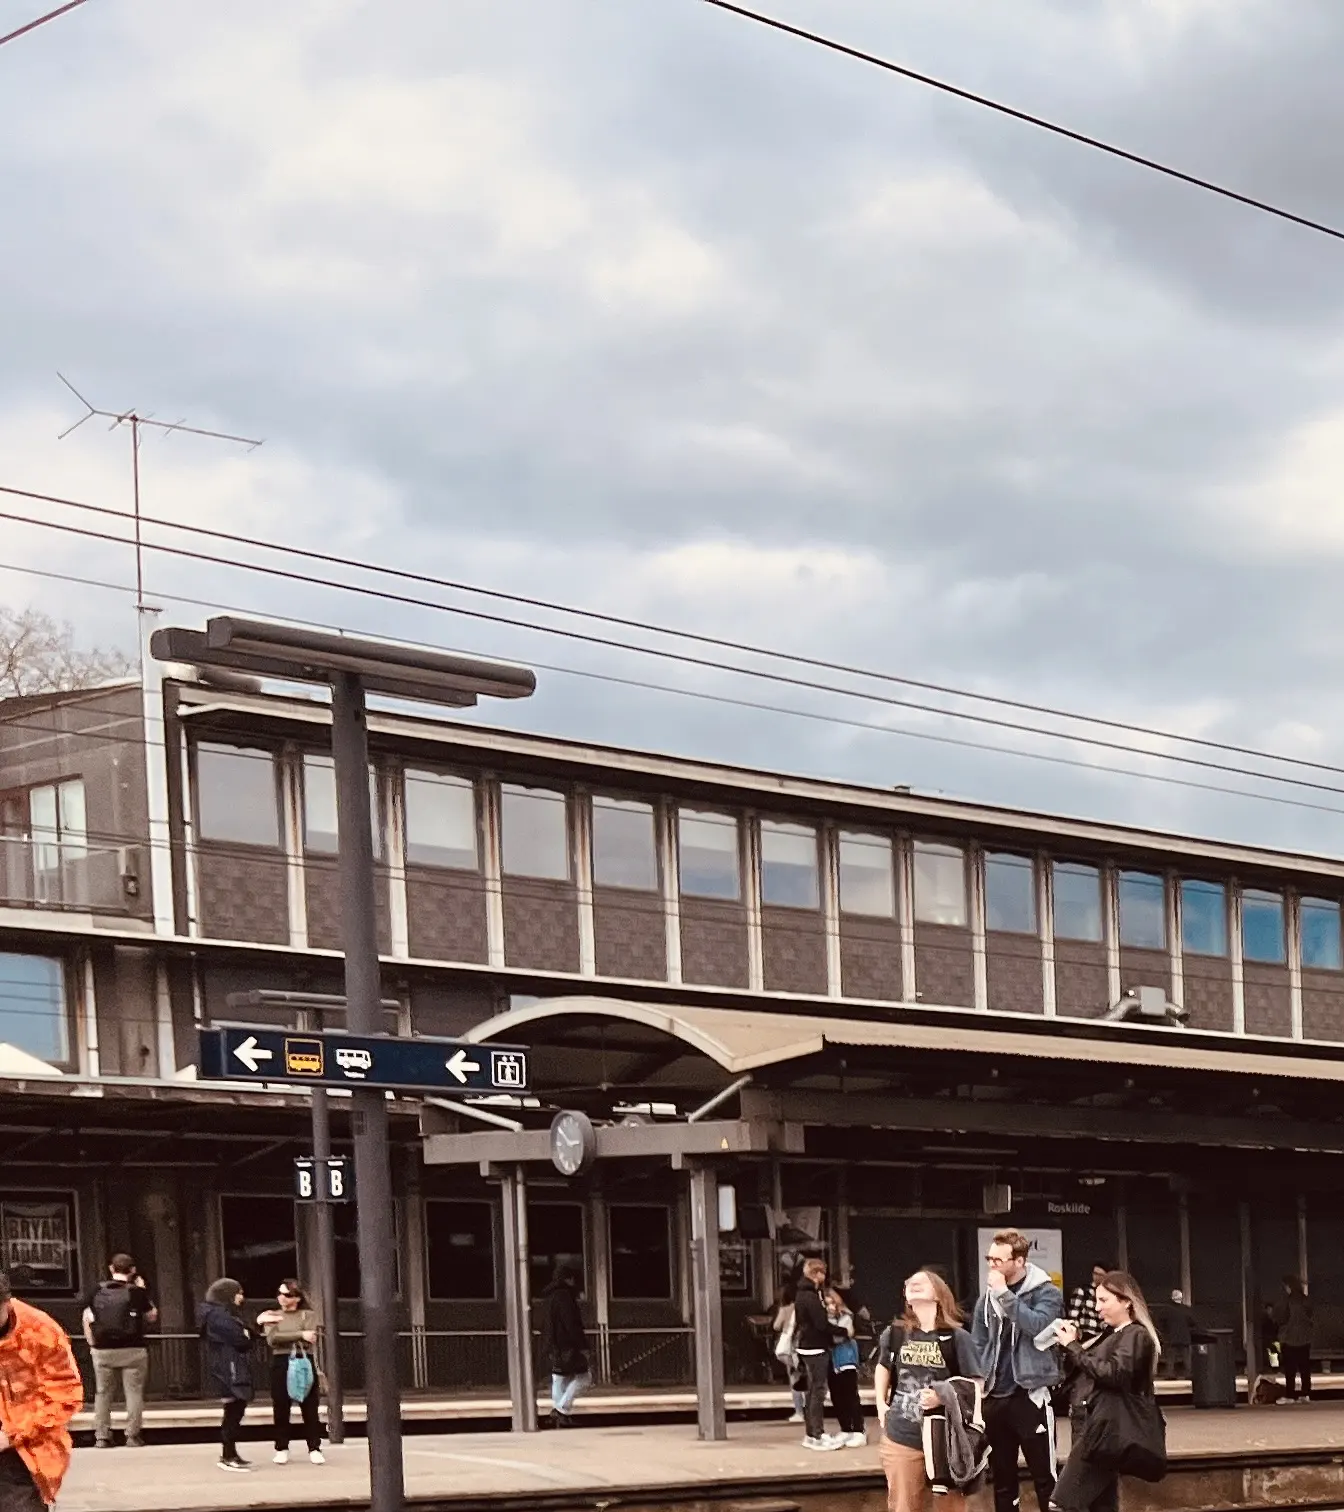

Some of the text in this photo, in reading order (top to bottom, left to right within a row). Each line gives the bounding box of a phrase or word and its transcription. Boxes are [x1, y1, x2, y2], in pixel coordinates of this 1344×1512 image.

[299, 1170, 312, 1197] B
[330, 1169, 344, 1196] B
[1047, 1201, 1092, 1215] Roskilde
